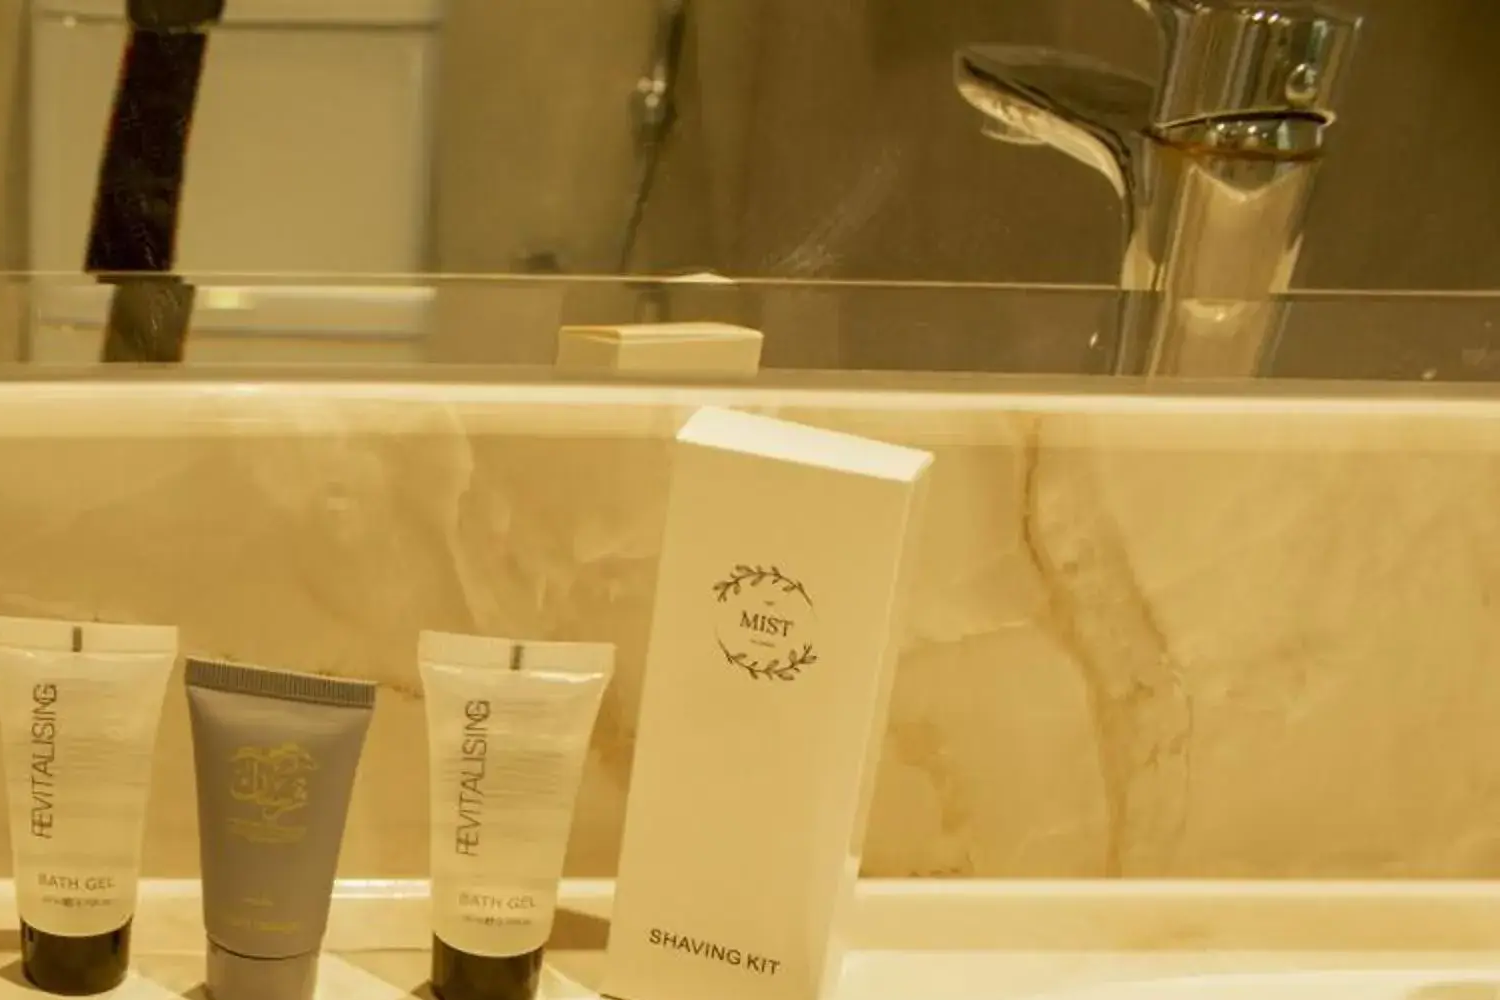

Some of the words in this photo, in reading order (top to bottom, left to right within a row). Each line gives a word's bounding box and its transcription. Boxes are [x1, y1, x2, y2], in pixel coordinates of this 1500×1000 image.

[739, 609, 794, 637] MIST
[30, 682, 58, 840] REVITALISING
[456, 699, 491, 858] REVITALISING
[38, 872, 80, 890] BATH
[85, 876, 117, 891] GEL
[506, 895, 537, 910] GEL
[649, 928, 742, 966] SHAVING
[746, 952, 781, 976] KIT
